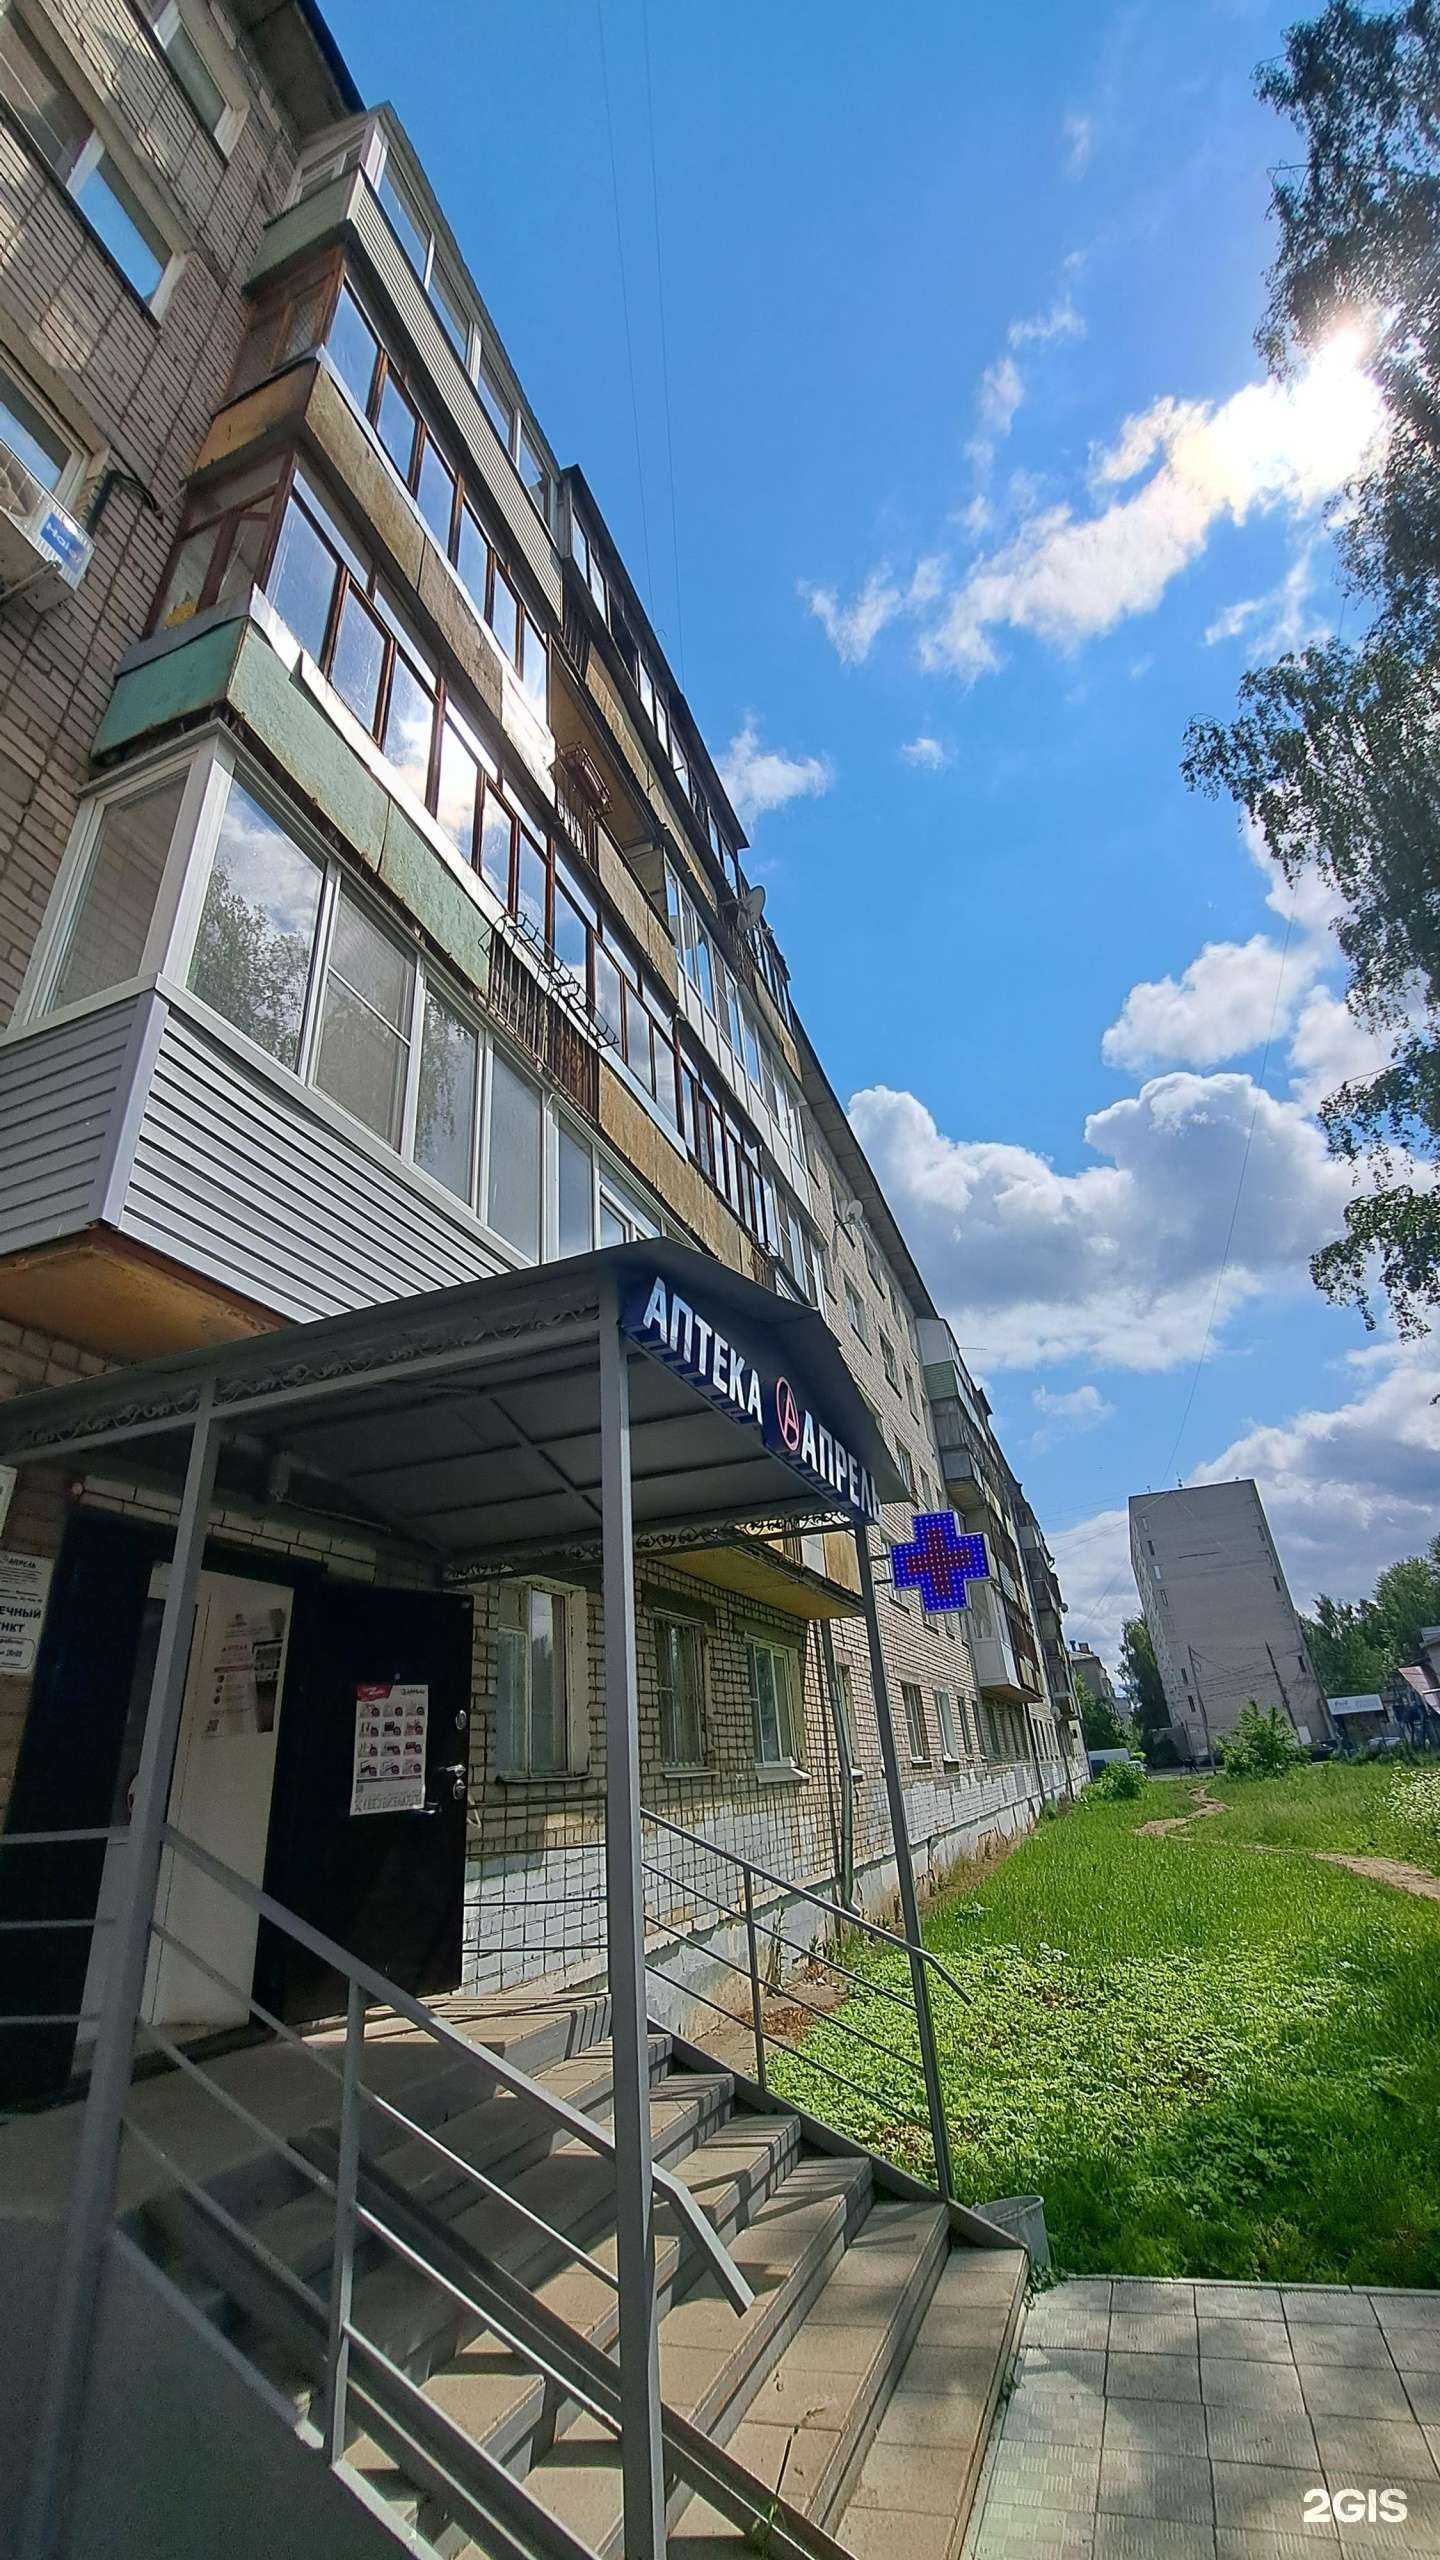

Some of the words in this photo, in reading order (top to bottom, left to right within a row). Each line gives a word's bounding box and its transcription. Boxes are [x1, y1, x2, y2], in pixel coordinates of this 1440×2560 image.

[643, 1276, 763, 1425] АПТЕКА
[801, 1409, 882, 1527] АПРЕЛЬ
[0, 1621, 25, 1632] НКТ
